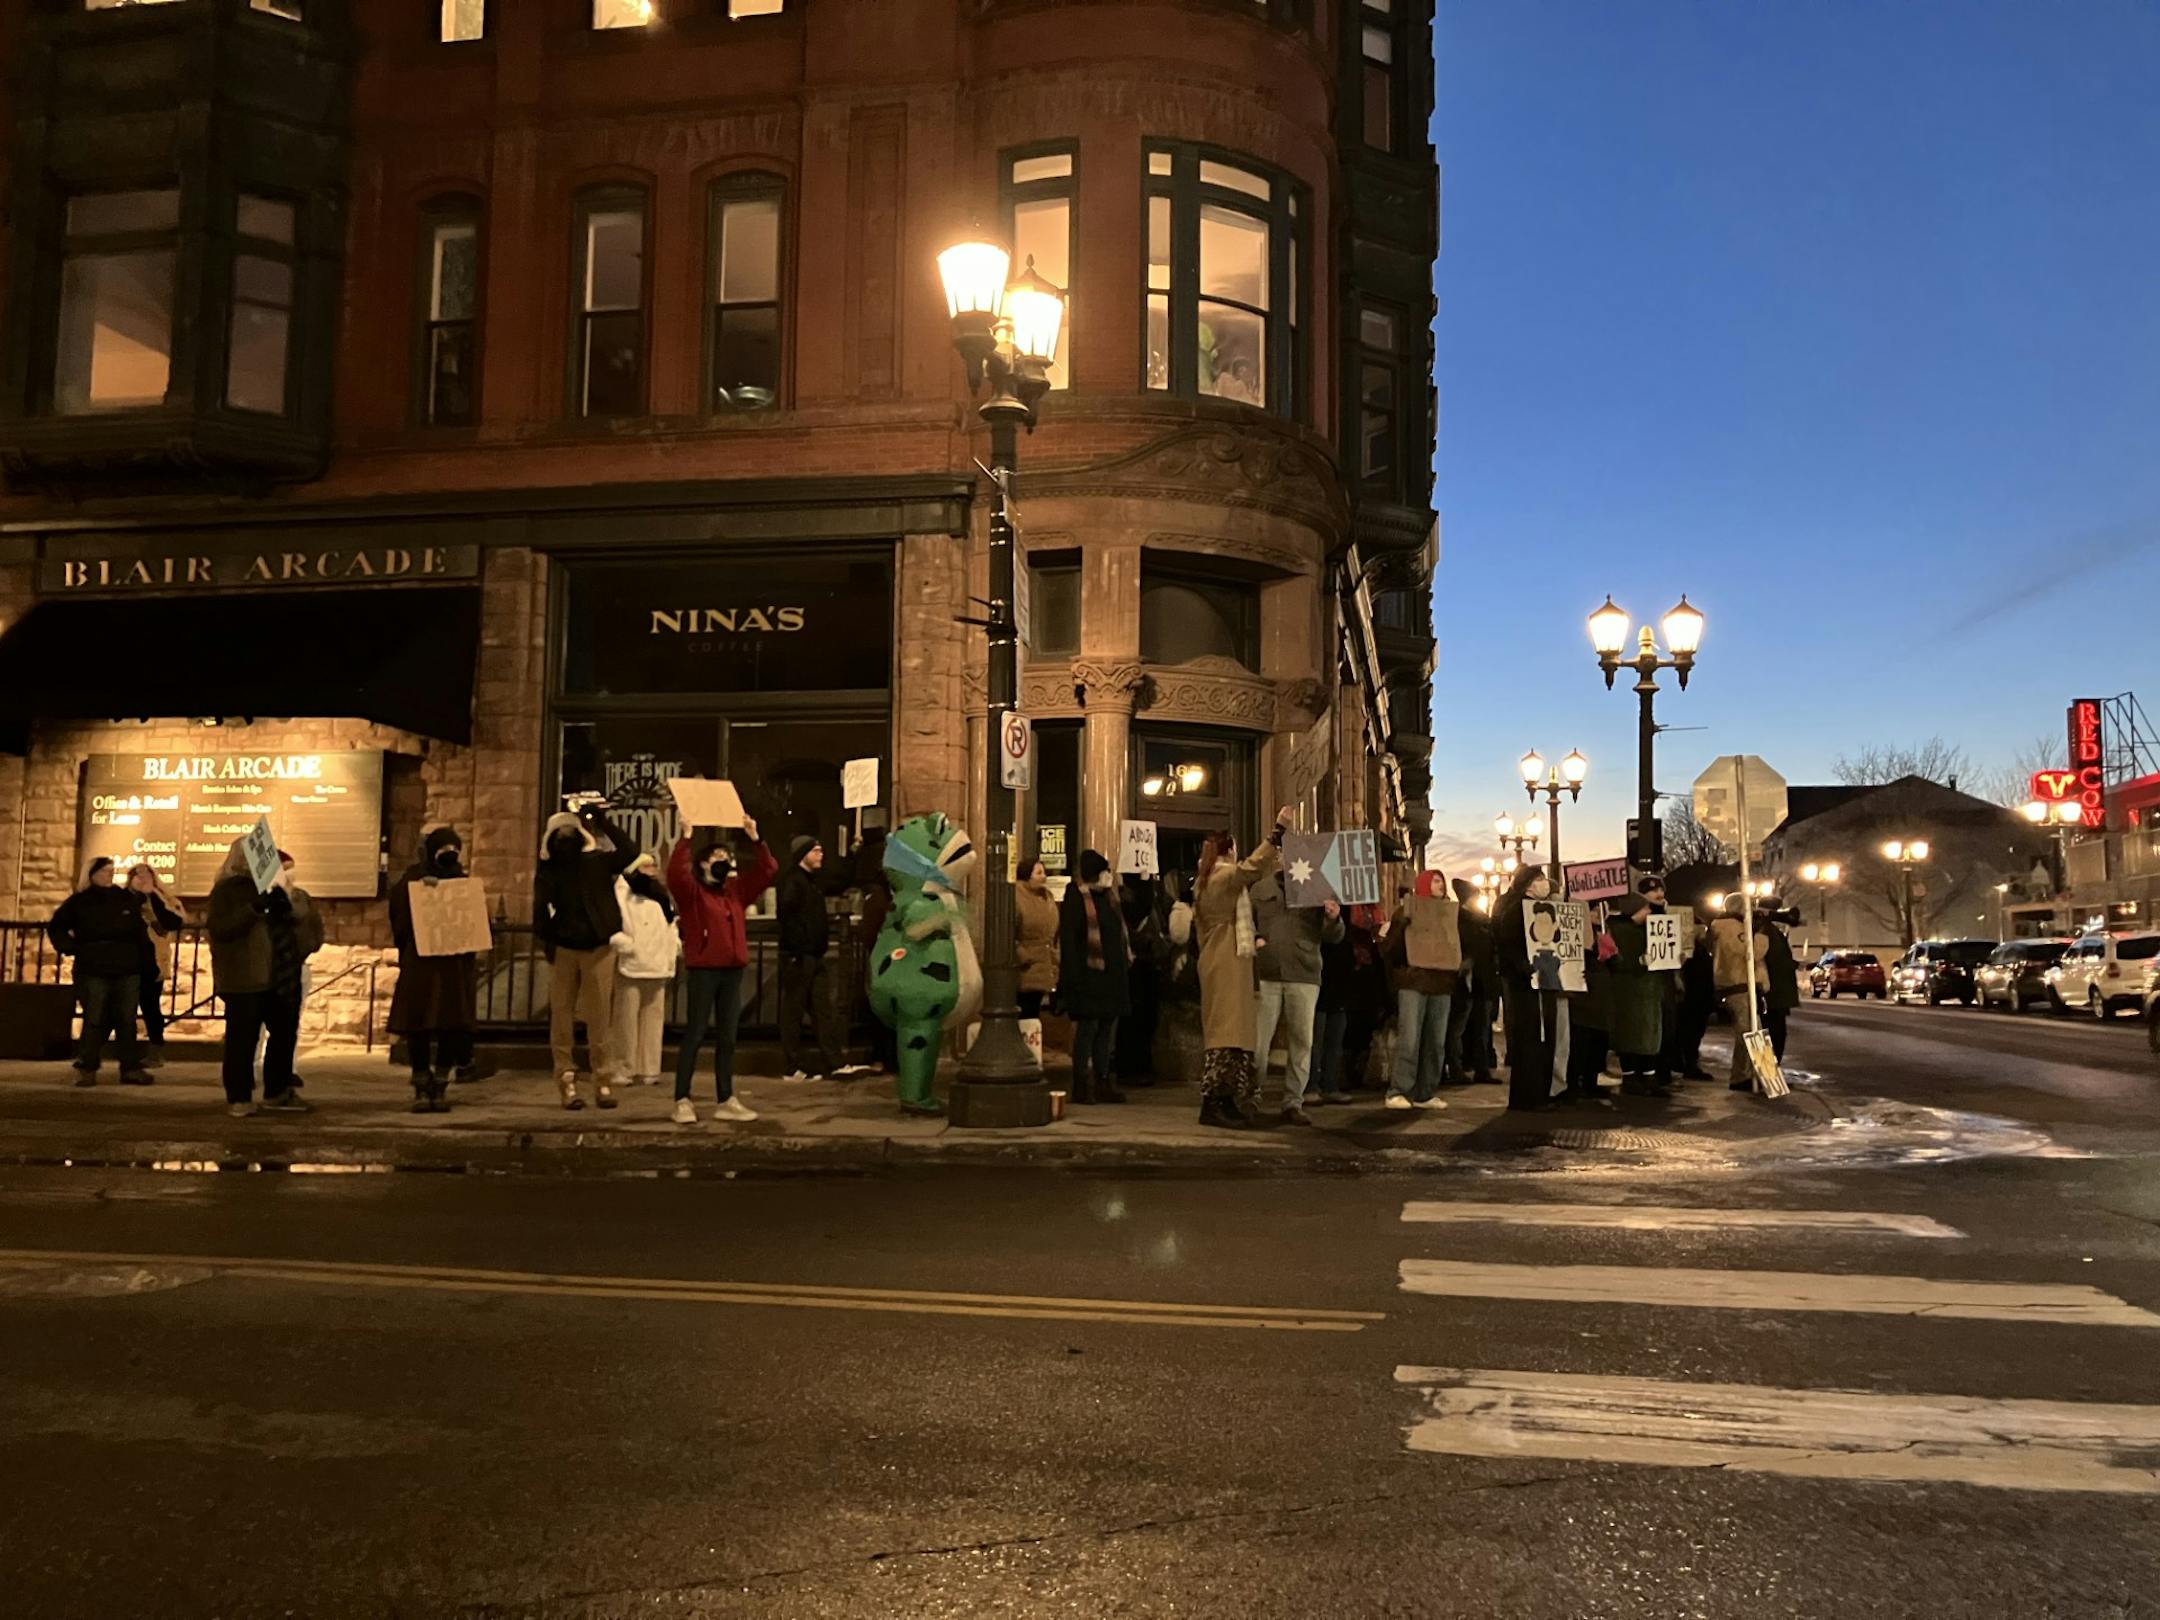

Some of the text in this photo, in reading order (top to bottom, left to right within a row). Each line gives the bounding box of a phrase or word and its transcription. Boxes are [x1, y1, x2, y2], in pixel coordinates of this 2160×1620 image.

[63, 547, 447, 587] BLAIR ARCADE
[650, 605, 805, 634] NINA'S
[143, 756, 321, 779] BLAIR ARCADE
[2079, 703, 2105, 826] RED COW
[604, 761, 638, 799] THERE
[641, 761, 653, 777] IS
[92, 795, 128, 809] Office
[92, 810, 107, 824] for
[1041, 829, 1065, 838] ICE
[133, 838, 176, 852] Contact
[1337, 831, 1375, 867] ICE
[1135, 850, 1149, 867] ICE
[1341, 866, 1376, 902] OUT
[1559, 916, 1582, 930] NOEM
[1557, 943, 1582, 958] CUNT
[1650, 942, 1676, 961] OUT
